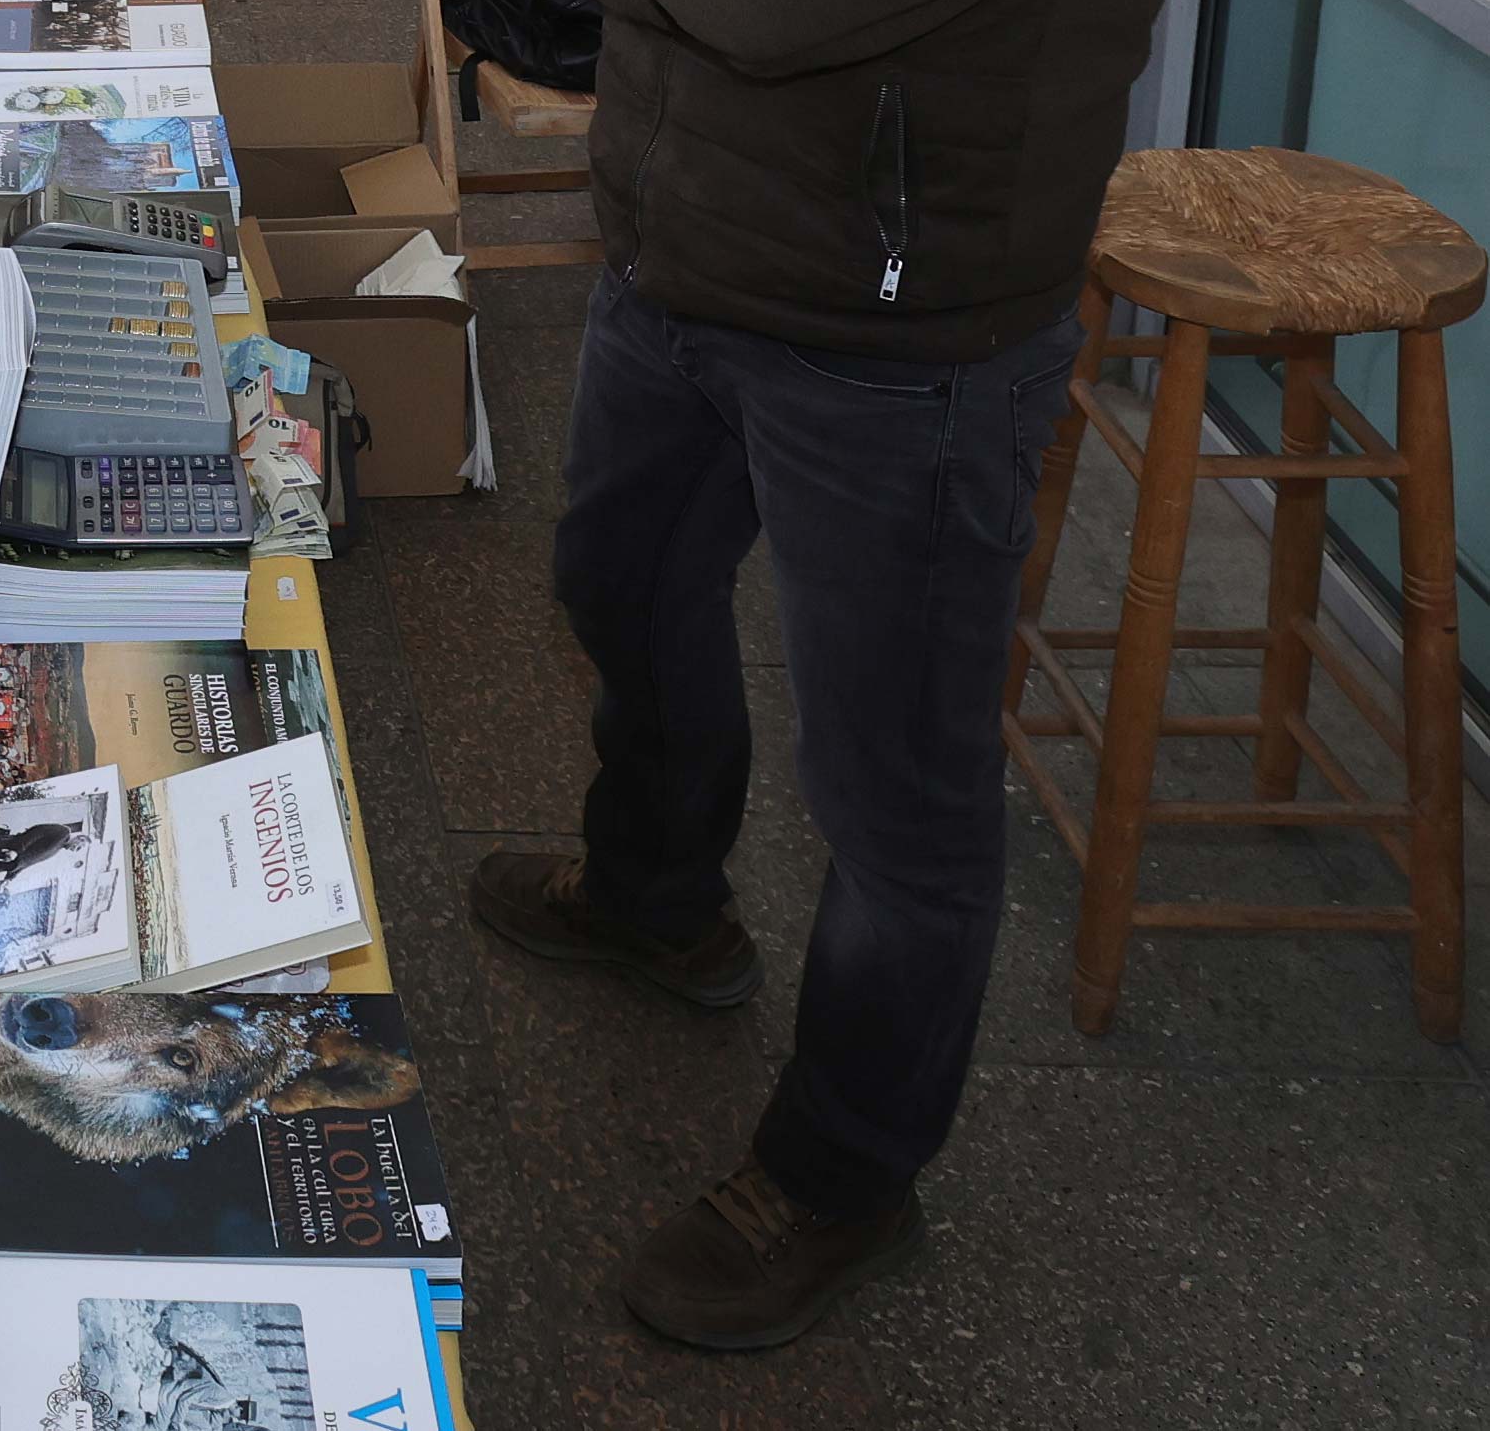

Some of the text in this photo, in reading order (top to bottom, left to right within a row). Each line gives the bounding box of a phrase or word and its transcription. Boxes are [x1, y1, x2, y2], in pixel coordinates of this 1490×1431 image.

[172, 87, 191, 108] VIDA
[163, 673, 197, 755] GUARDO
[188, 673, 215, 754] SINGULARES DE
[205, 673, 239, 754] HISTORIAS
[264, 663, 286, 726] EL CONJUNTO
[248, 778, 294, 904] INGENIOS
[277, 773, 315, 897] LA CORTE DE LOS
[323, 1121, 384, 1247] LOBO
